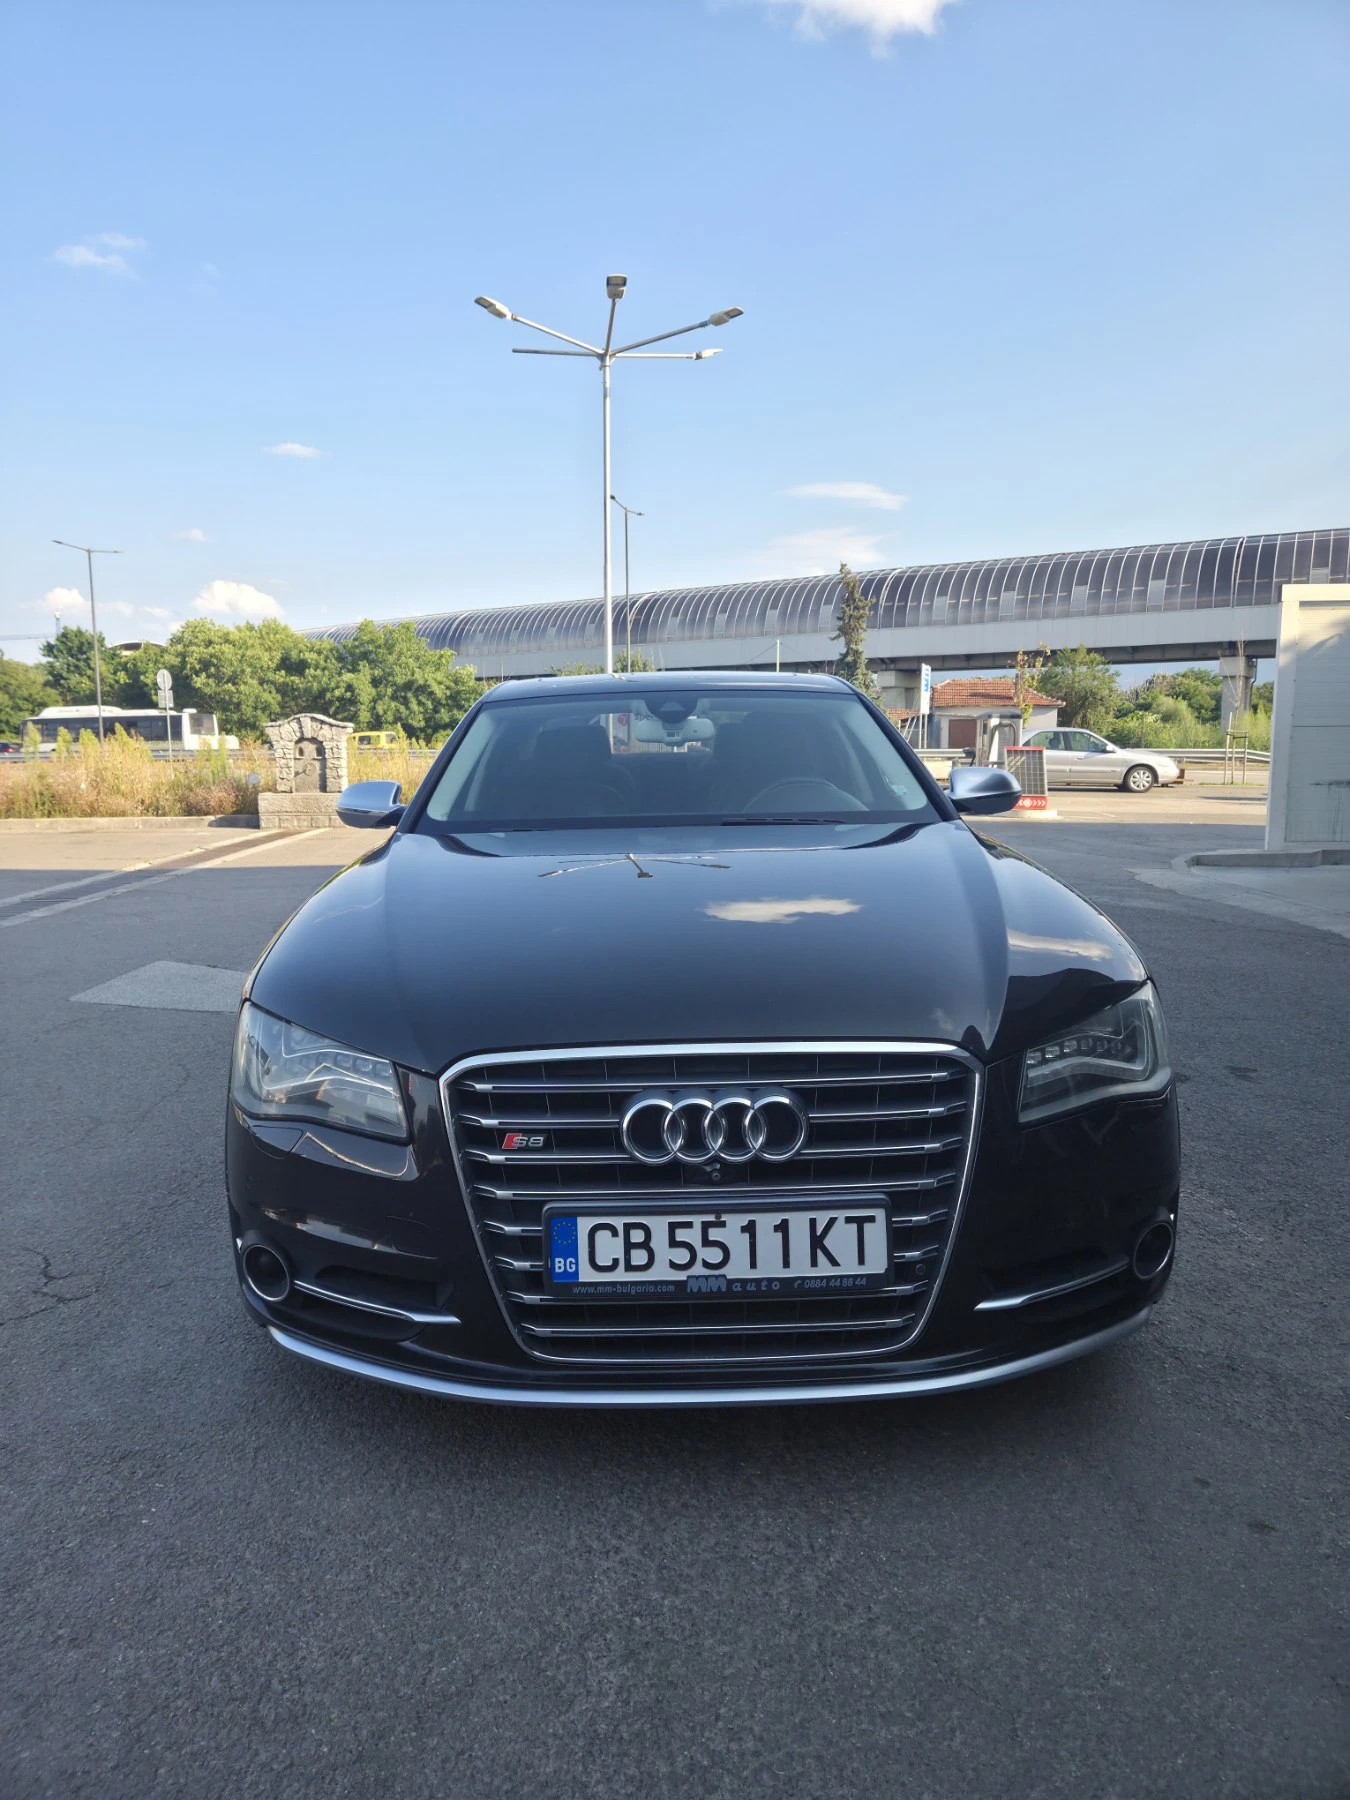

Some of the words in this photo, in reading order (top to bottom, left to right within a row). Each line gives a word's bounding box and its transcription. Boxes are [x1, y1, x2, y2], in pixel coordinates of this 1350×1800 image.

[512, 1136, 544, 1147] S8
[554, 1257, 577, 1273] BG
[572, 1283, 675, 1295] www.mm-bulgaria.com
[732, 1280, 780, 1291] auto
[804, 1279, 827, 1289] 0884
